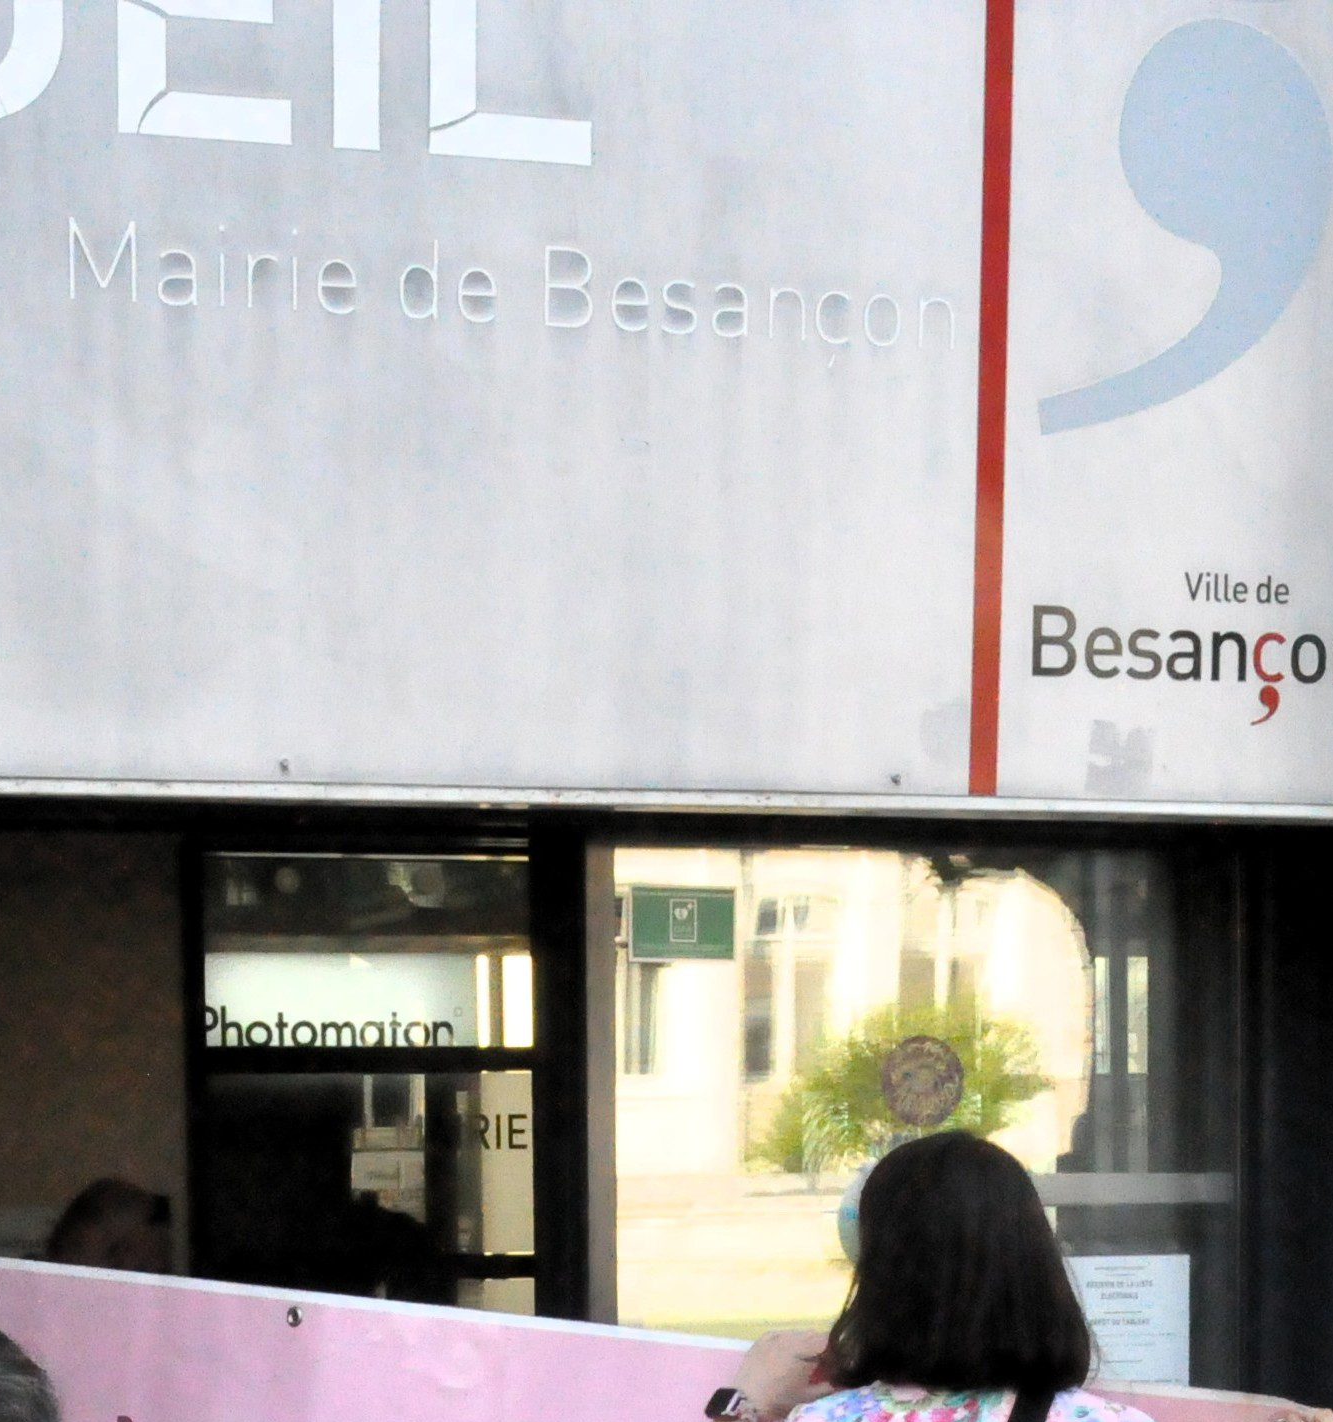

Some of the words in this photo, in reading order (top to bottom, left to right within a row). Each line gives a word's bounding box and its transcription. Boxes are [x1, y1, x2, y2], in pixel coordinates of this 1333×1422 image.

[67, 217, 358, 315] Mairie
[398, 240, 498, 322] de
[544, 245, 955, 366] Besançon
[1185, 572, 1248, 604] Ville
[1256, 576, 1290, 604] de
